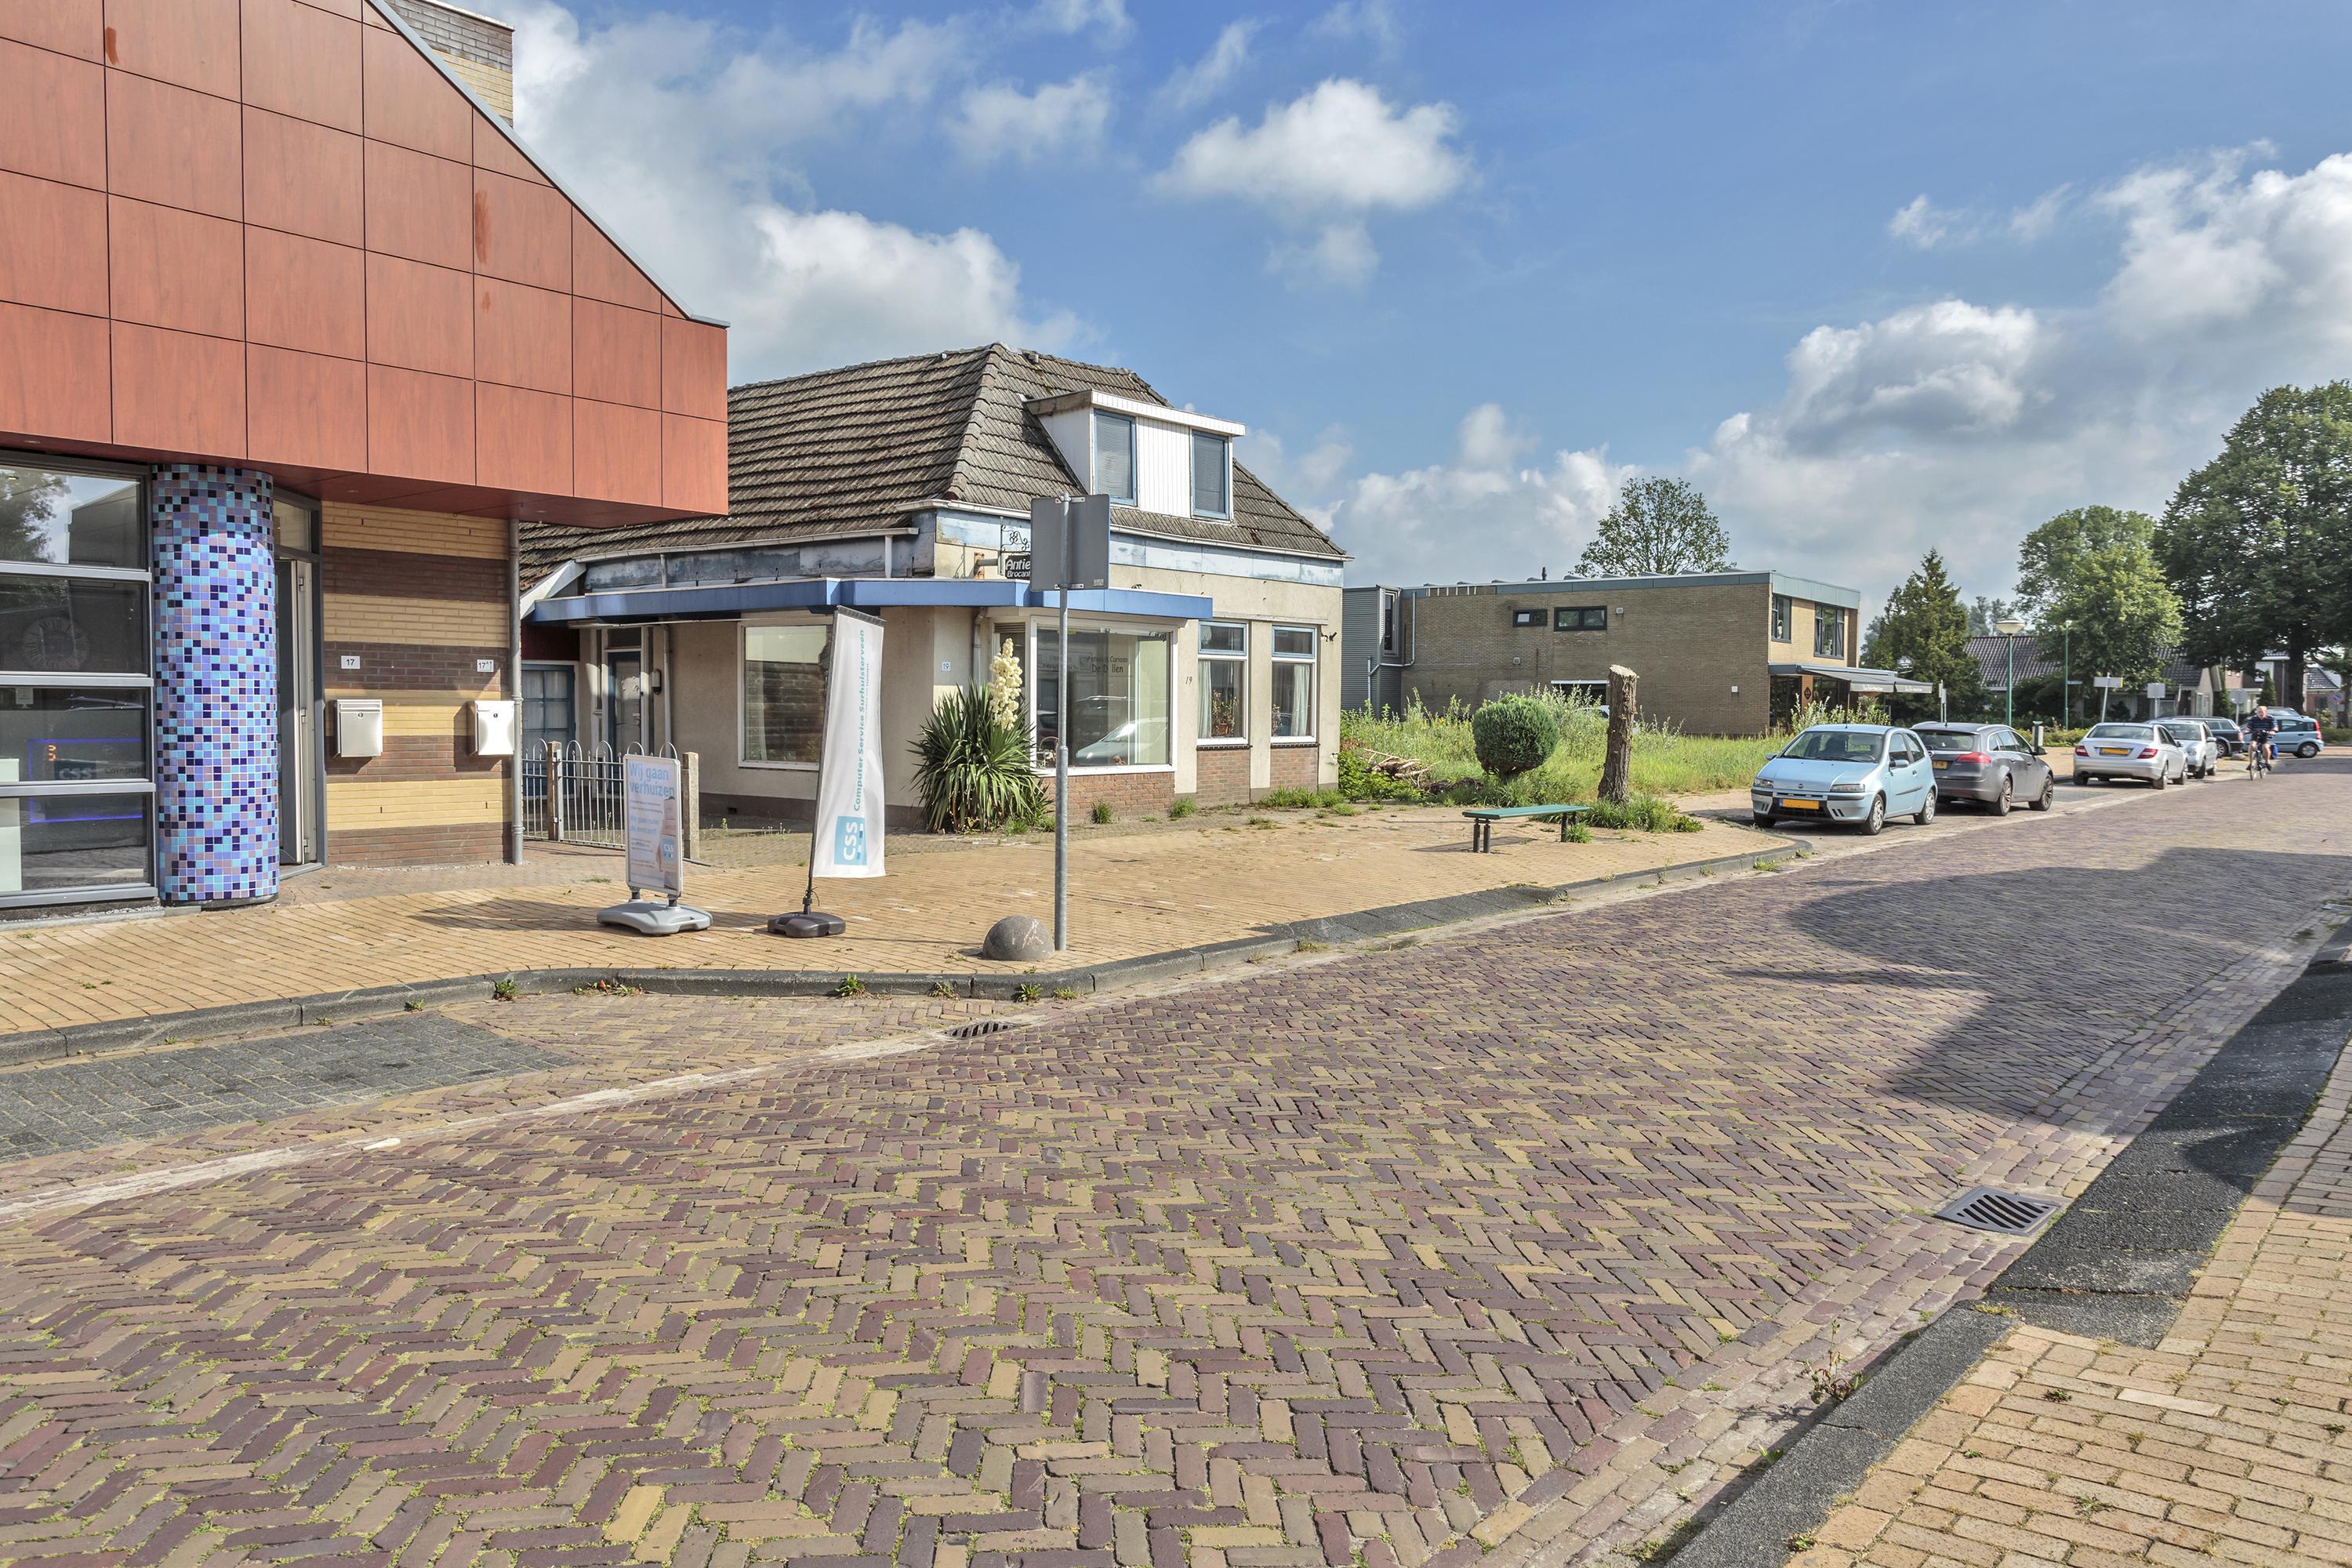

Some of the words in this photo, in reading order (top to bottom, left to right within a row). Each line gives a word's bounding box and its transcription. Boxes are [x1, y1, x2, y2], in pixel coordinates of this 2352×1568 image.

[1006, 558, 1031, 570] Antie
[1185, 676, 1192, 684] 19
[104, 765, 144, 775] Comput
[629, 762, 643, 781] Wij
[646, 768, 669, 782] gaan
[630, 780, 675, 797] verhuizen
[853, 757, 863, 812] Computer
[844, 822, 858, 861] CSS
